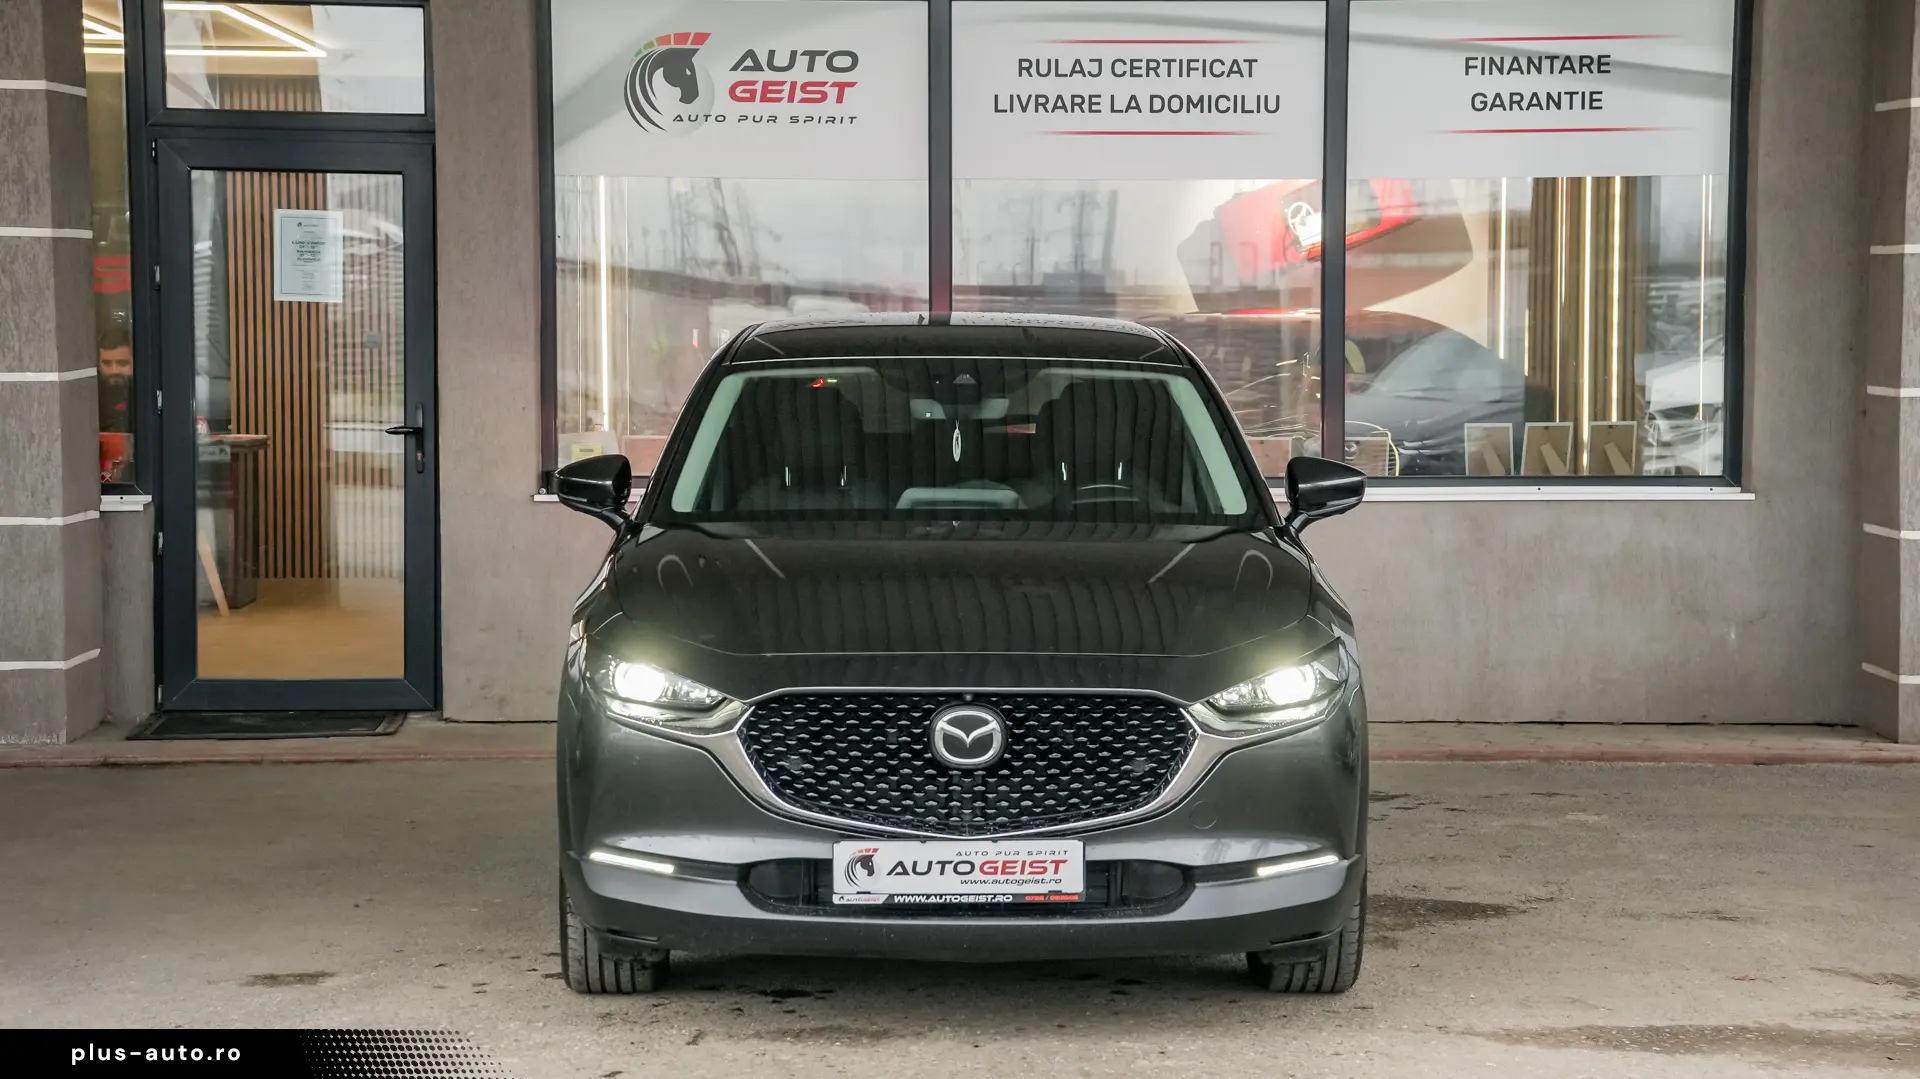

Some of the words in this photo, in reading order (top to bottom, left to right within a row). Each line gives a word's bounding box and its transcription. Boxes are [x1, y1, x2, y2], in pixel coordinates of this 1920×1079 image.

[728, 48, 859, 73] AUTO
[1017, 58, 1103, 78] RULAJ
[1110, 58, 1259, 79] CERTIFICAT
[1464, 54, 1612, 76] FINANTARE
[728, 79, 858, 104] GEIST
[1470, 90, 1604, 112] GARANTIE
[994, 93, 1102, 114] LIVRARE
[1110, 93, 1143, 114] LA
[1149, 93, 1281, 114] DOMICILIU
[672, 113, 727, 123] AUTO
[737, 114, 778, 124] PUR
[789, 115, 858, 125] SPIRIT
[886, 859, 1069, 876] AUTOGEIST
[960, 877, 1063, 887] www.autogeist.ro
[894, 894, 1013, 903] WWW.AUTOGEIST.RO
